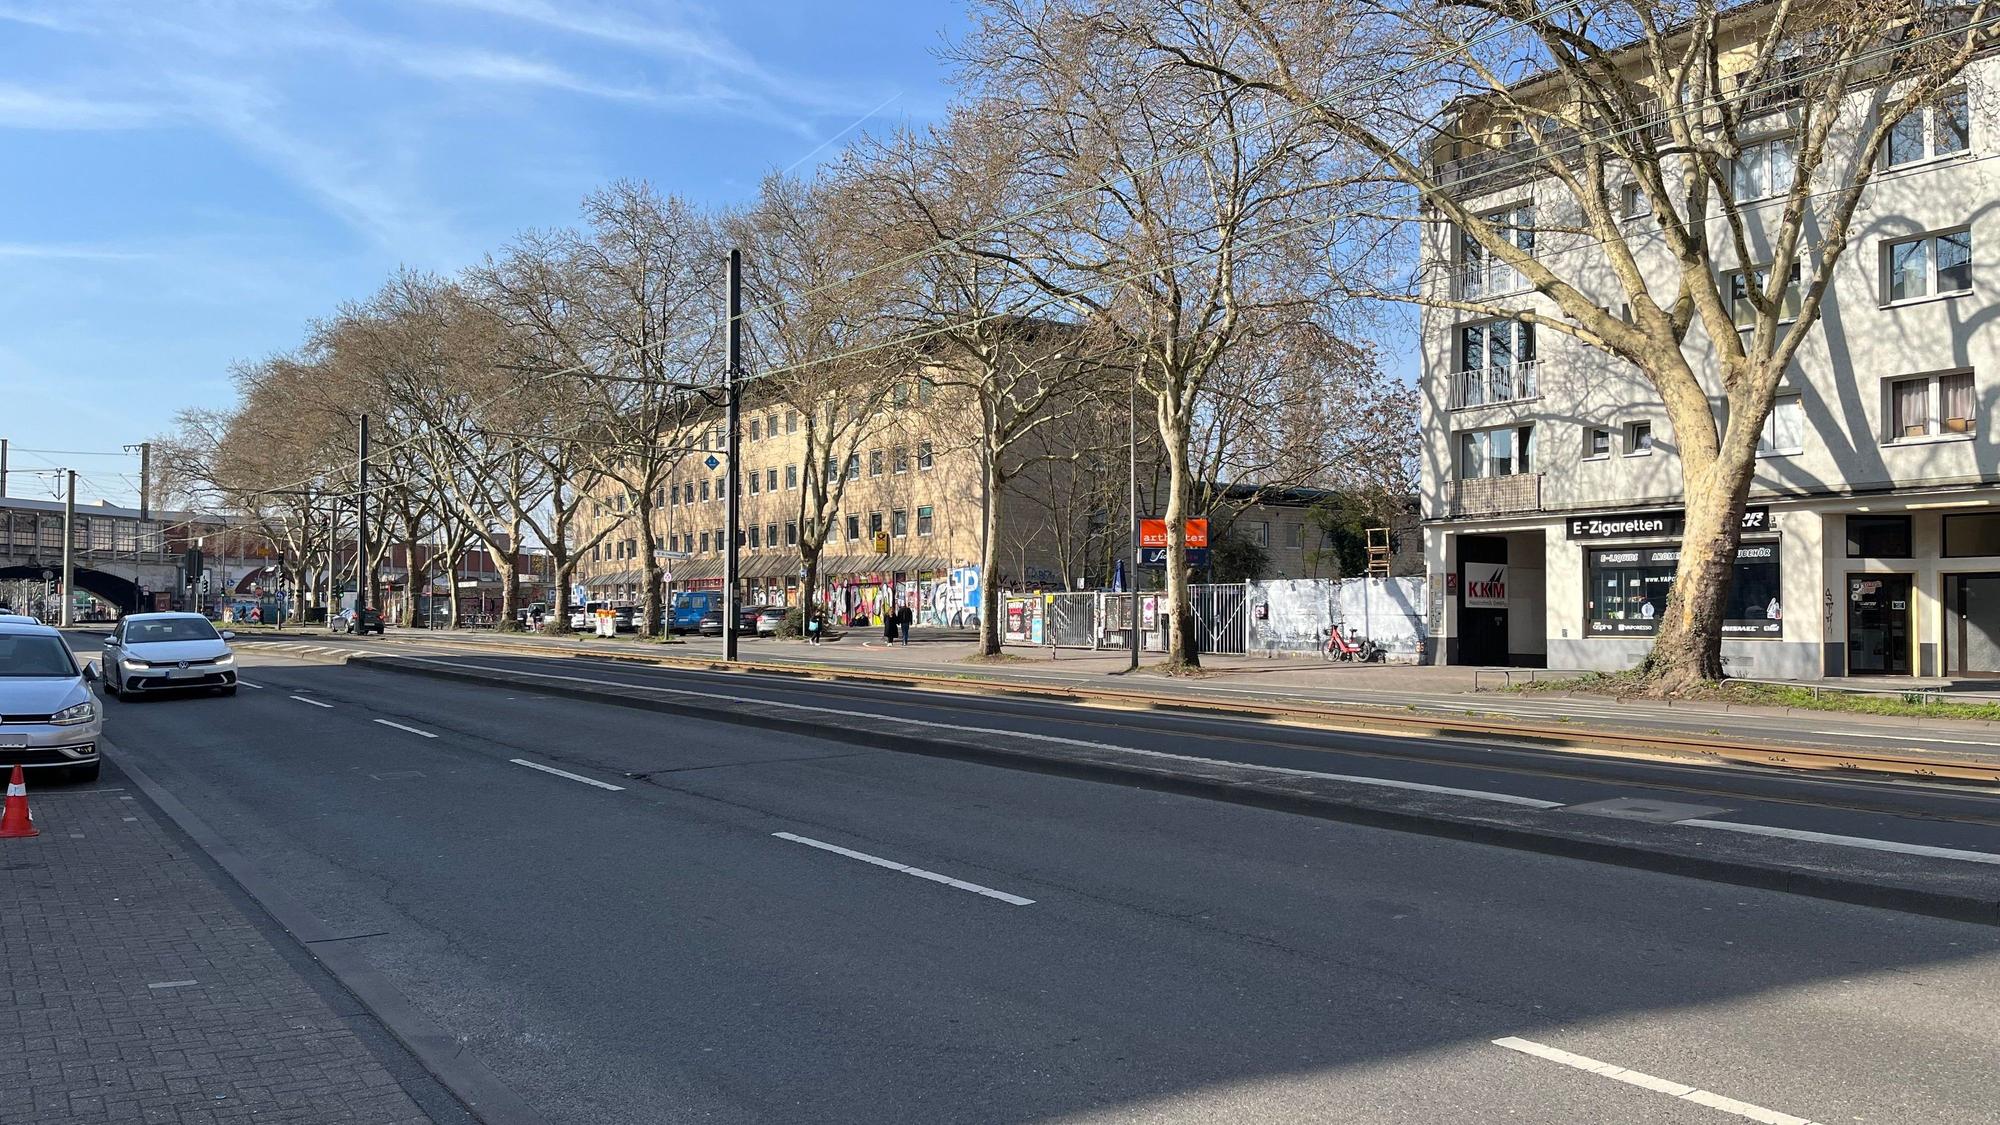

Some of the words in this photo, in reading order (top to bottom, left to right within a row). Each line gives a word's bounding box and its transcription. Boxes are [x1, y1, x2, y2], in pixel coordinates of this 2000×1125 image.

[1573, 520, 1663, 536] E-Zigaretten
[1600, 553, 1639, 563] E-LIQUIDS
[1652, 552, 1681, 561] AROME
